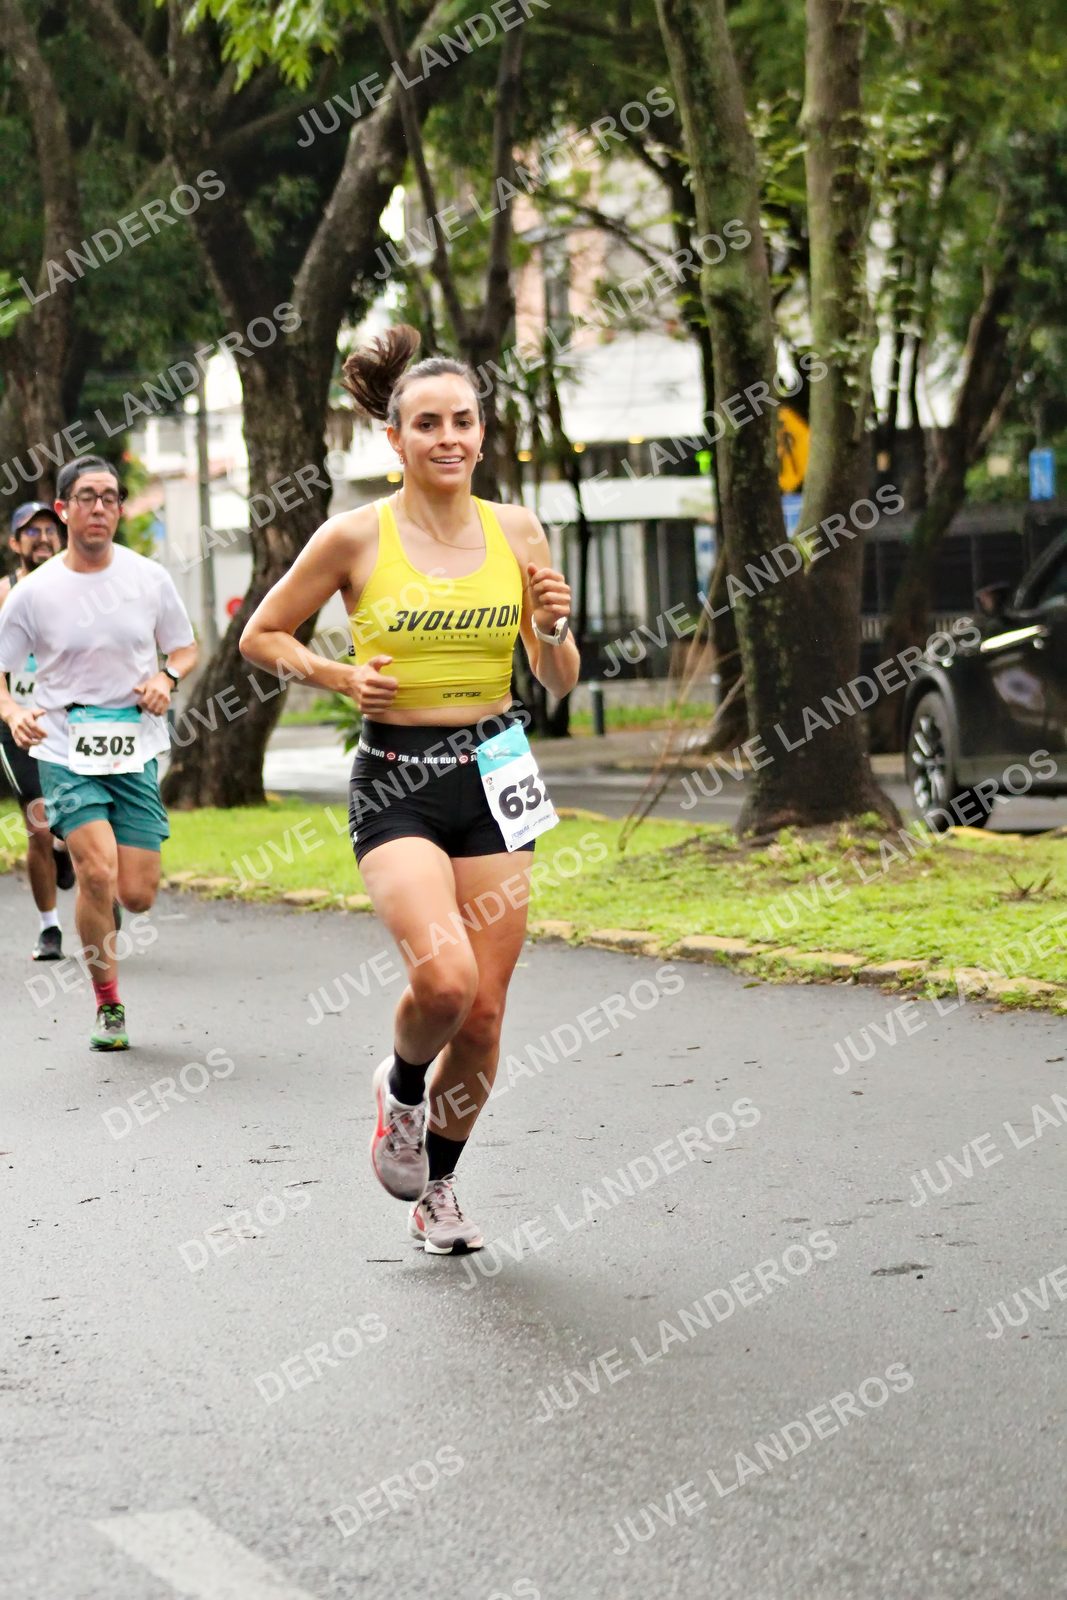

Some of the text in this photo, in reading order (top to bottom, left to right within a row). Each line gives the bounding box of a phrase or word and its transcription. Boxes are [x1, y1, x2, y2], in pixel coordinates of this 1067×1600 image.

[388, 604, 520, 632] 3VOLUTION
[76, 736, 136, 756] 4303
[398, 754, 418, 764] SWM
[440, 756, 456, 764] RUN
